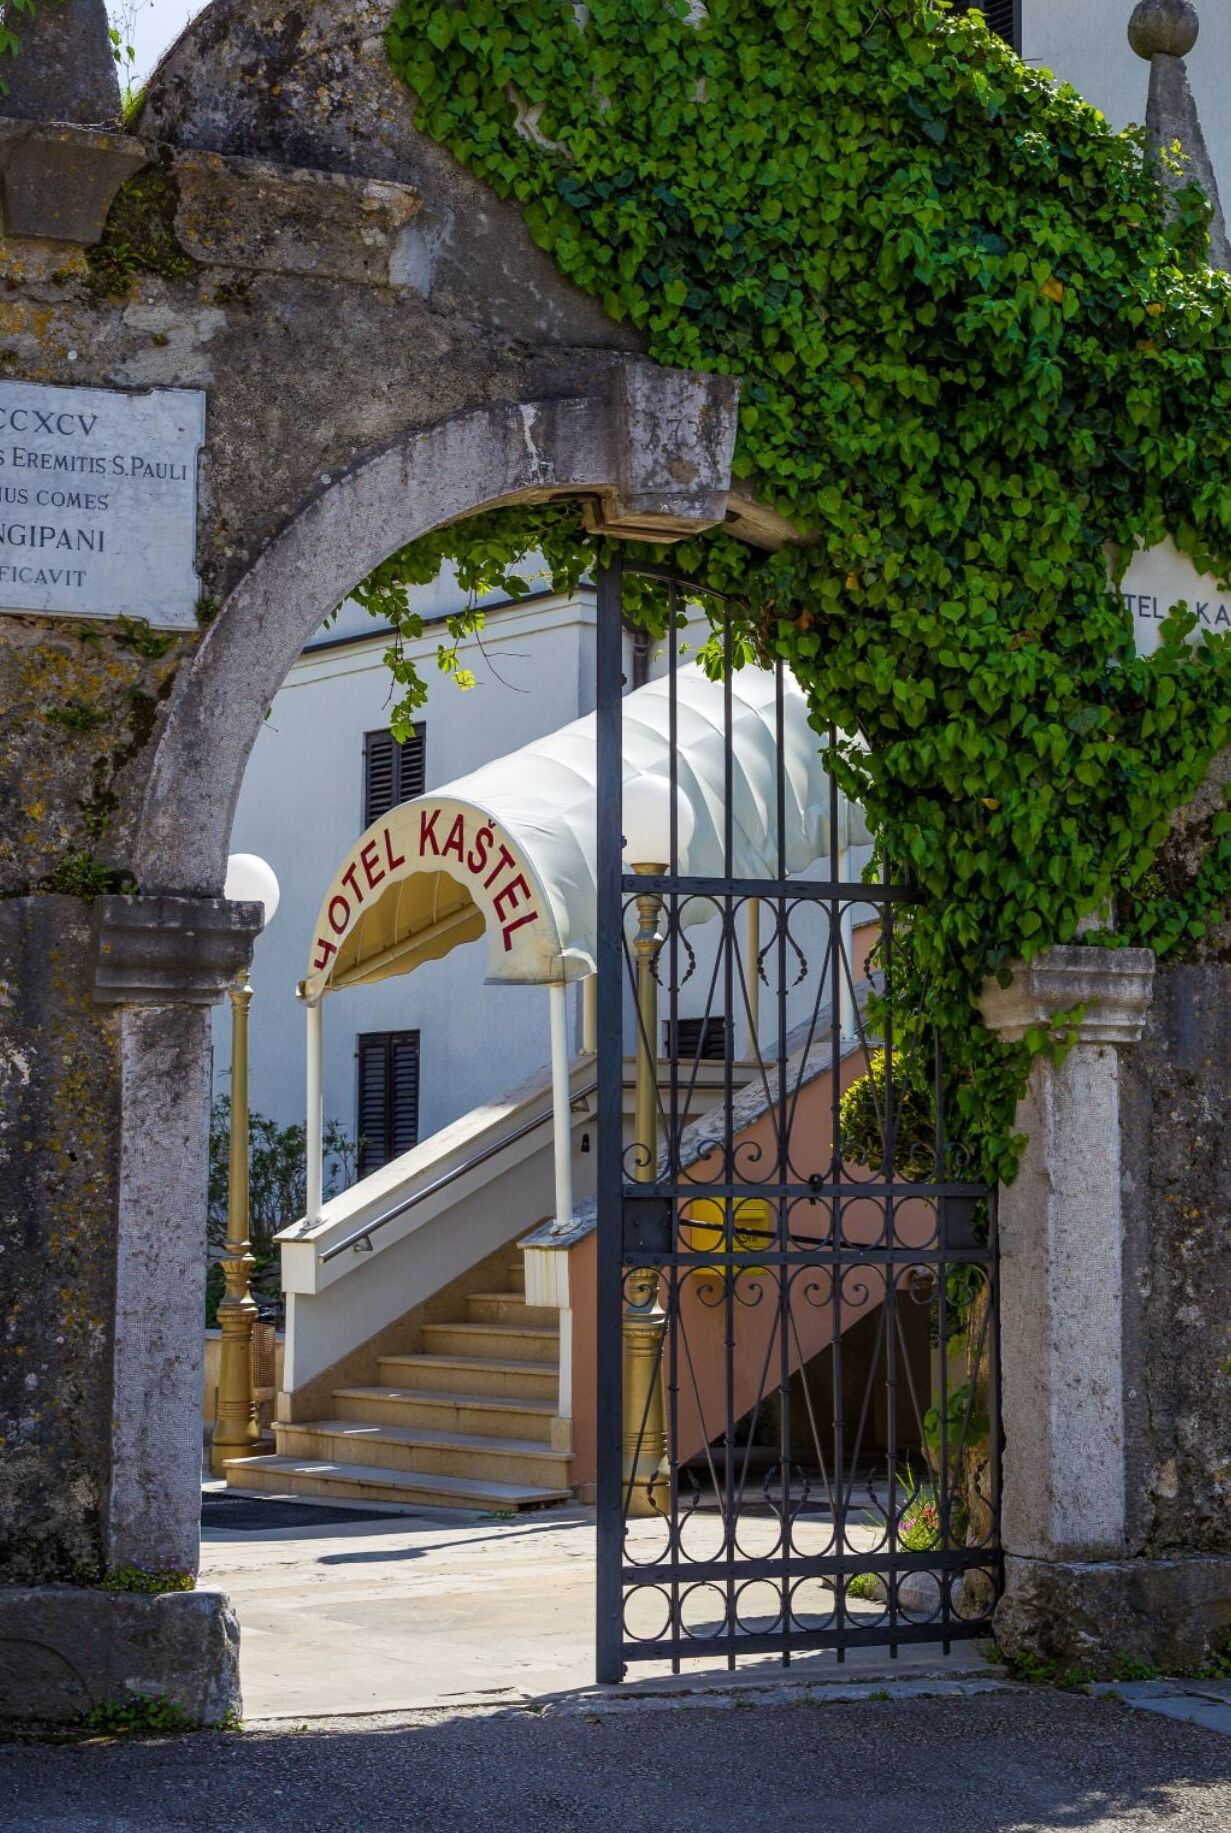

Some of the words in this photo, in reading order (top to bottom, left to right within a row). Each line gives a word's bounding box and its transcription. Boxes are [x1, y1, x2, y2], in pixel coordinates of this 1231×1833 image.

[0, 487, 28, 504] US
[36, 490, 109, 511] COMES
[314, 829, 405, 970] HOTEL
[419, 809, 538, 952] KAŠTEL
